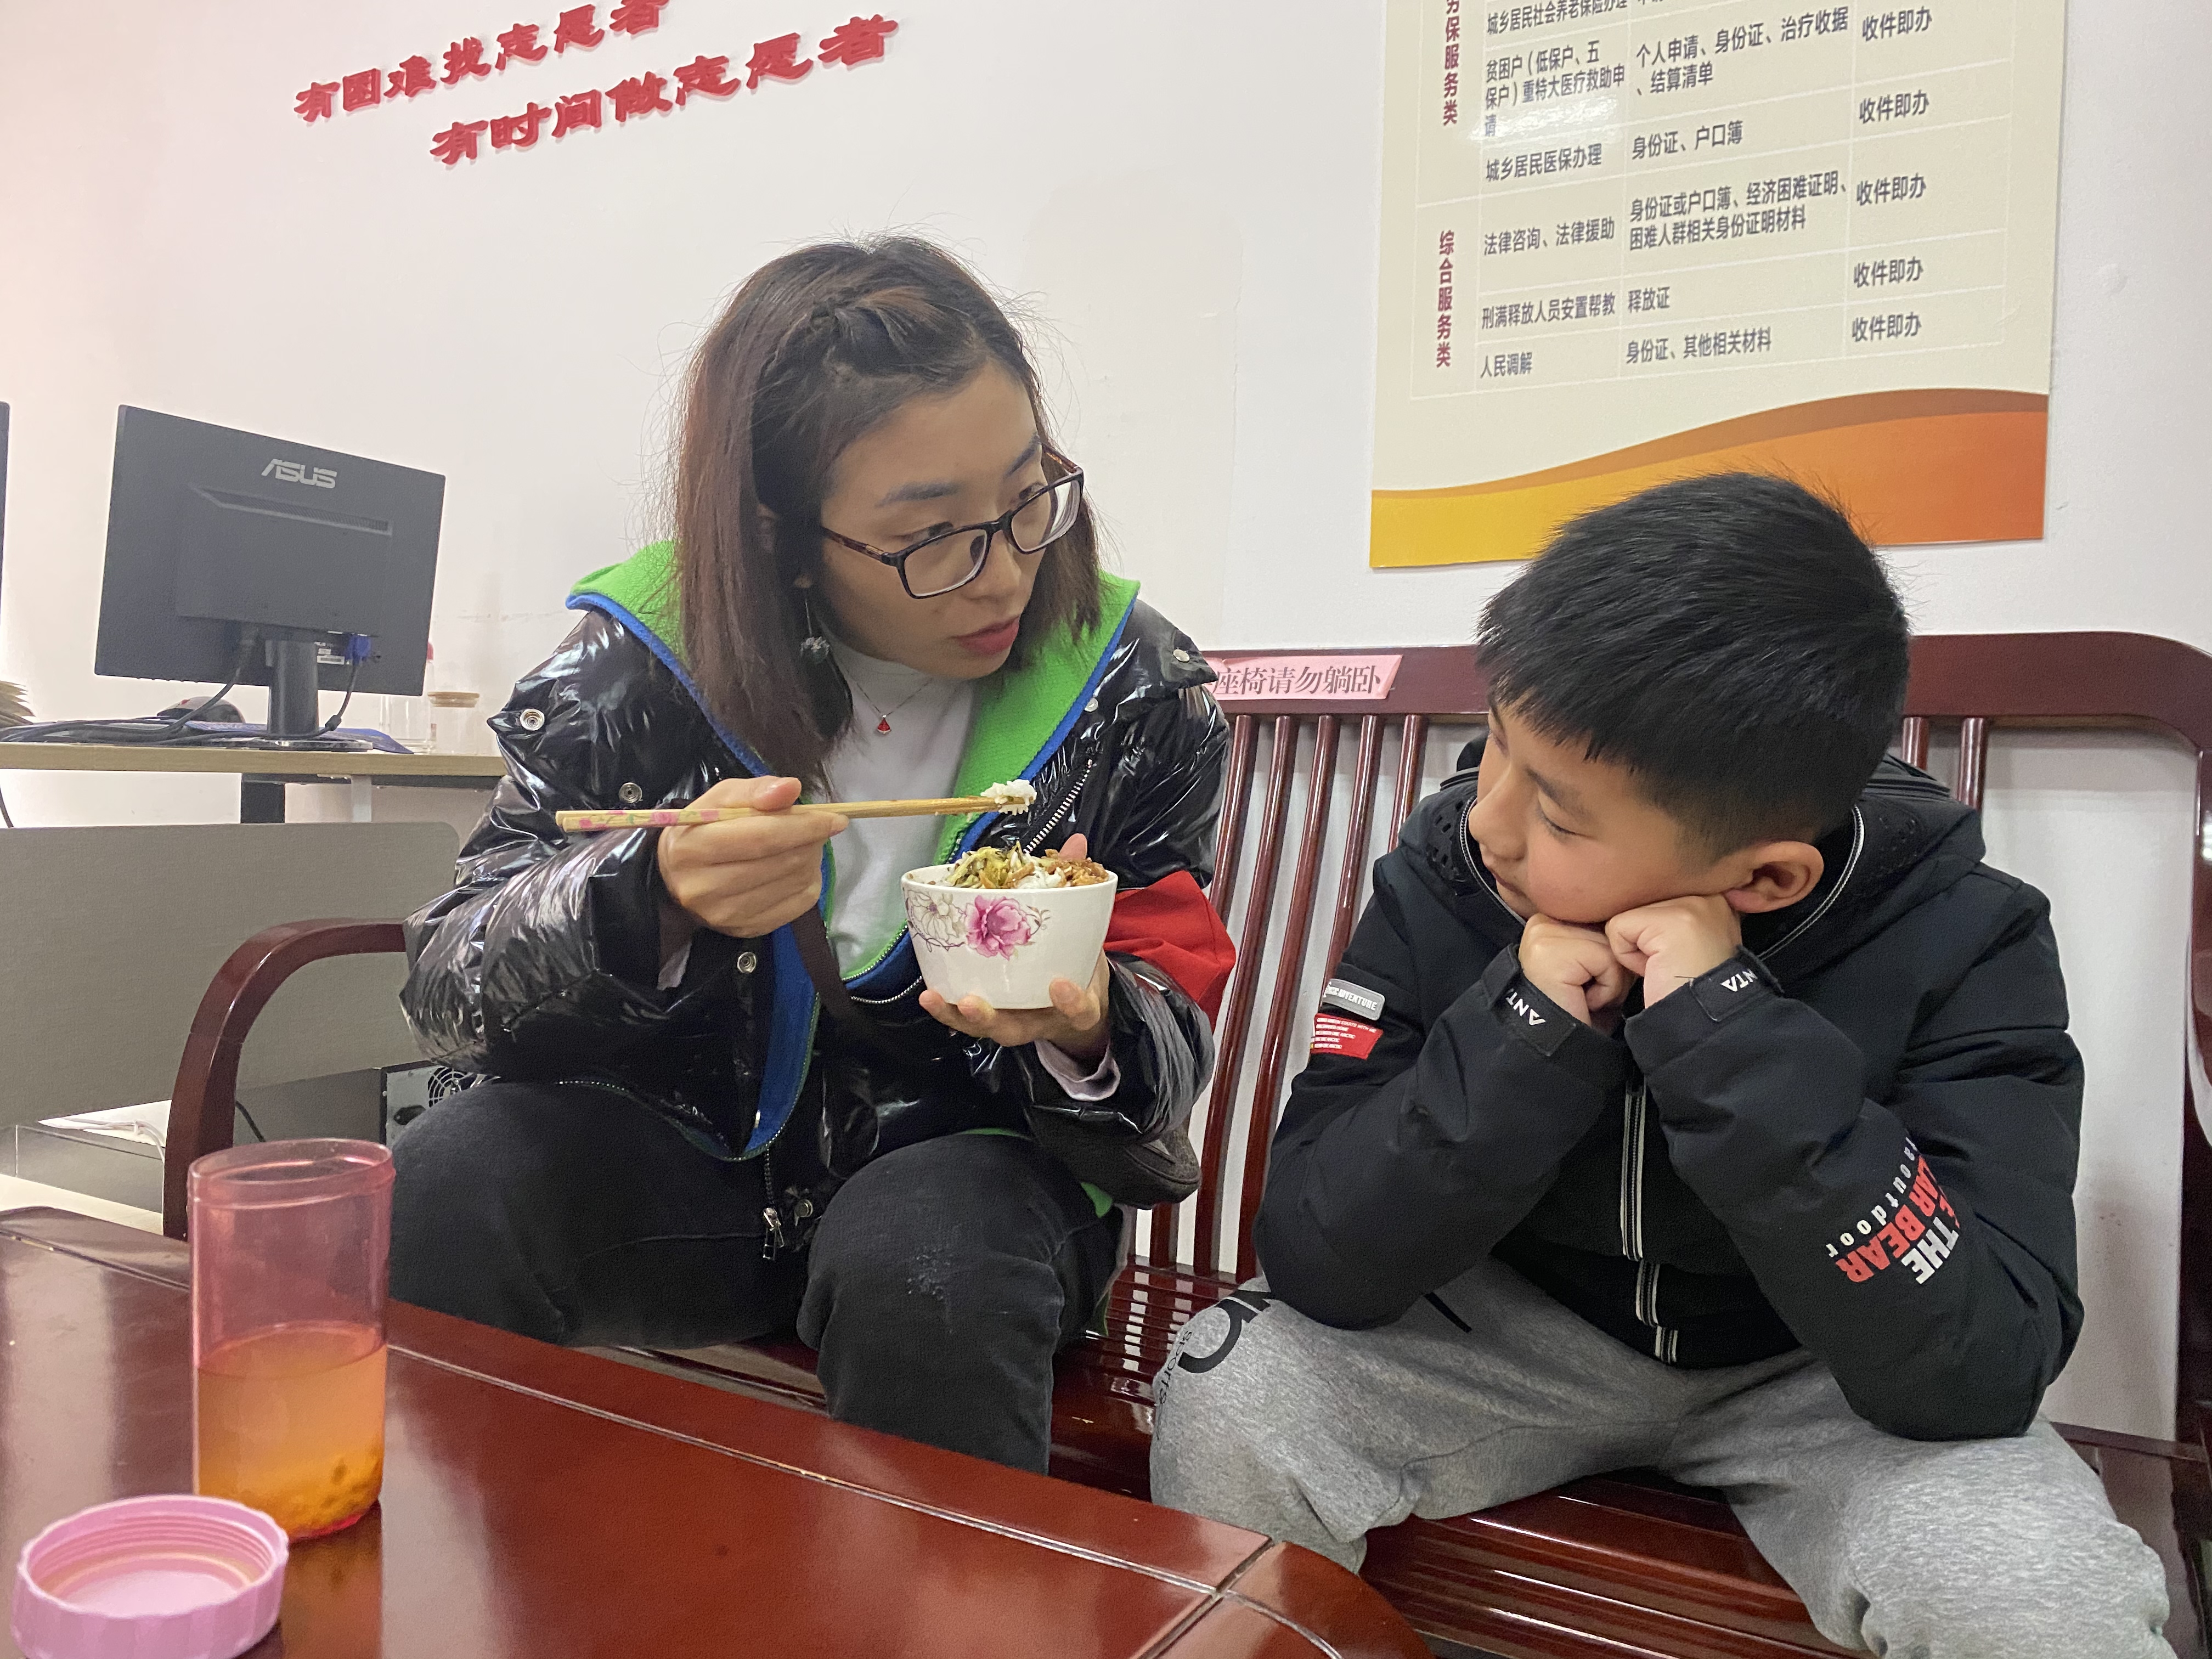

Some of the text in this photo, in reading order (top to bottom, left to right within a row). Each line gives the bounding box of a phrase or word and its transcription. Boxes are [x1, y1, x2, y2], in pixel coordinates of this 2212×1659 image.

[1636, 6, 1849, 68] 个人申请、身份证、治疗收据
[1862, 6, 1933, 41] 收件即办
[295, 0, 668, 122] 有困难找志愿者
[430, 14, 899, 165] 有时间做志愿者
[1859, 89, 1929, 125] 收件即办
[1484, 114, 1497, 137] 请
[1632, 120, 1743, 160] 身份证、户口簿
[1486, 143, 1602, 182] 城乡居民医保办理
[1630, 170, 1847, 223] 身份证或户口簿、经济困难证明、
[1857, 173, 1927, 206] 收件即办
[1483, 217, 1615, 256] 法律咨询、法律援助
[1629, 205, 1806, 251] 困难人群相关身份证明材料
[1854, 256, 1923, 289] 收件即办
[1436, 229, 1455, 368] 综合服务类
[1481, 292, 1616, 330] 刑满释放人员安置帮教
[1628, 286, 1671, 314] 释放证
[1626, 326, 1771, 364] 身份证、其他相关材料
[1852, 312, 1922, 343] 收件即办
[1480, 351, 1533, 379] 人民调解
[261, 459, 337, 489] ASUS
[1201, 665, 1381, 696] 座椅请勿躺卧
[1506, 989, 1545, 1025] ANT
[1826, 1164, 1911, 1257] outdoor
[1835, 1204, 1926, 1282] BEAR
[1901, 1216, 1959, 1284] THE
[1159, 1330, 1192, 1405] sports
